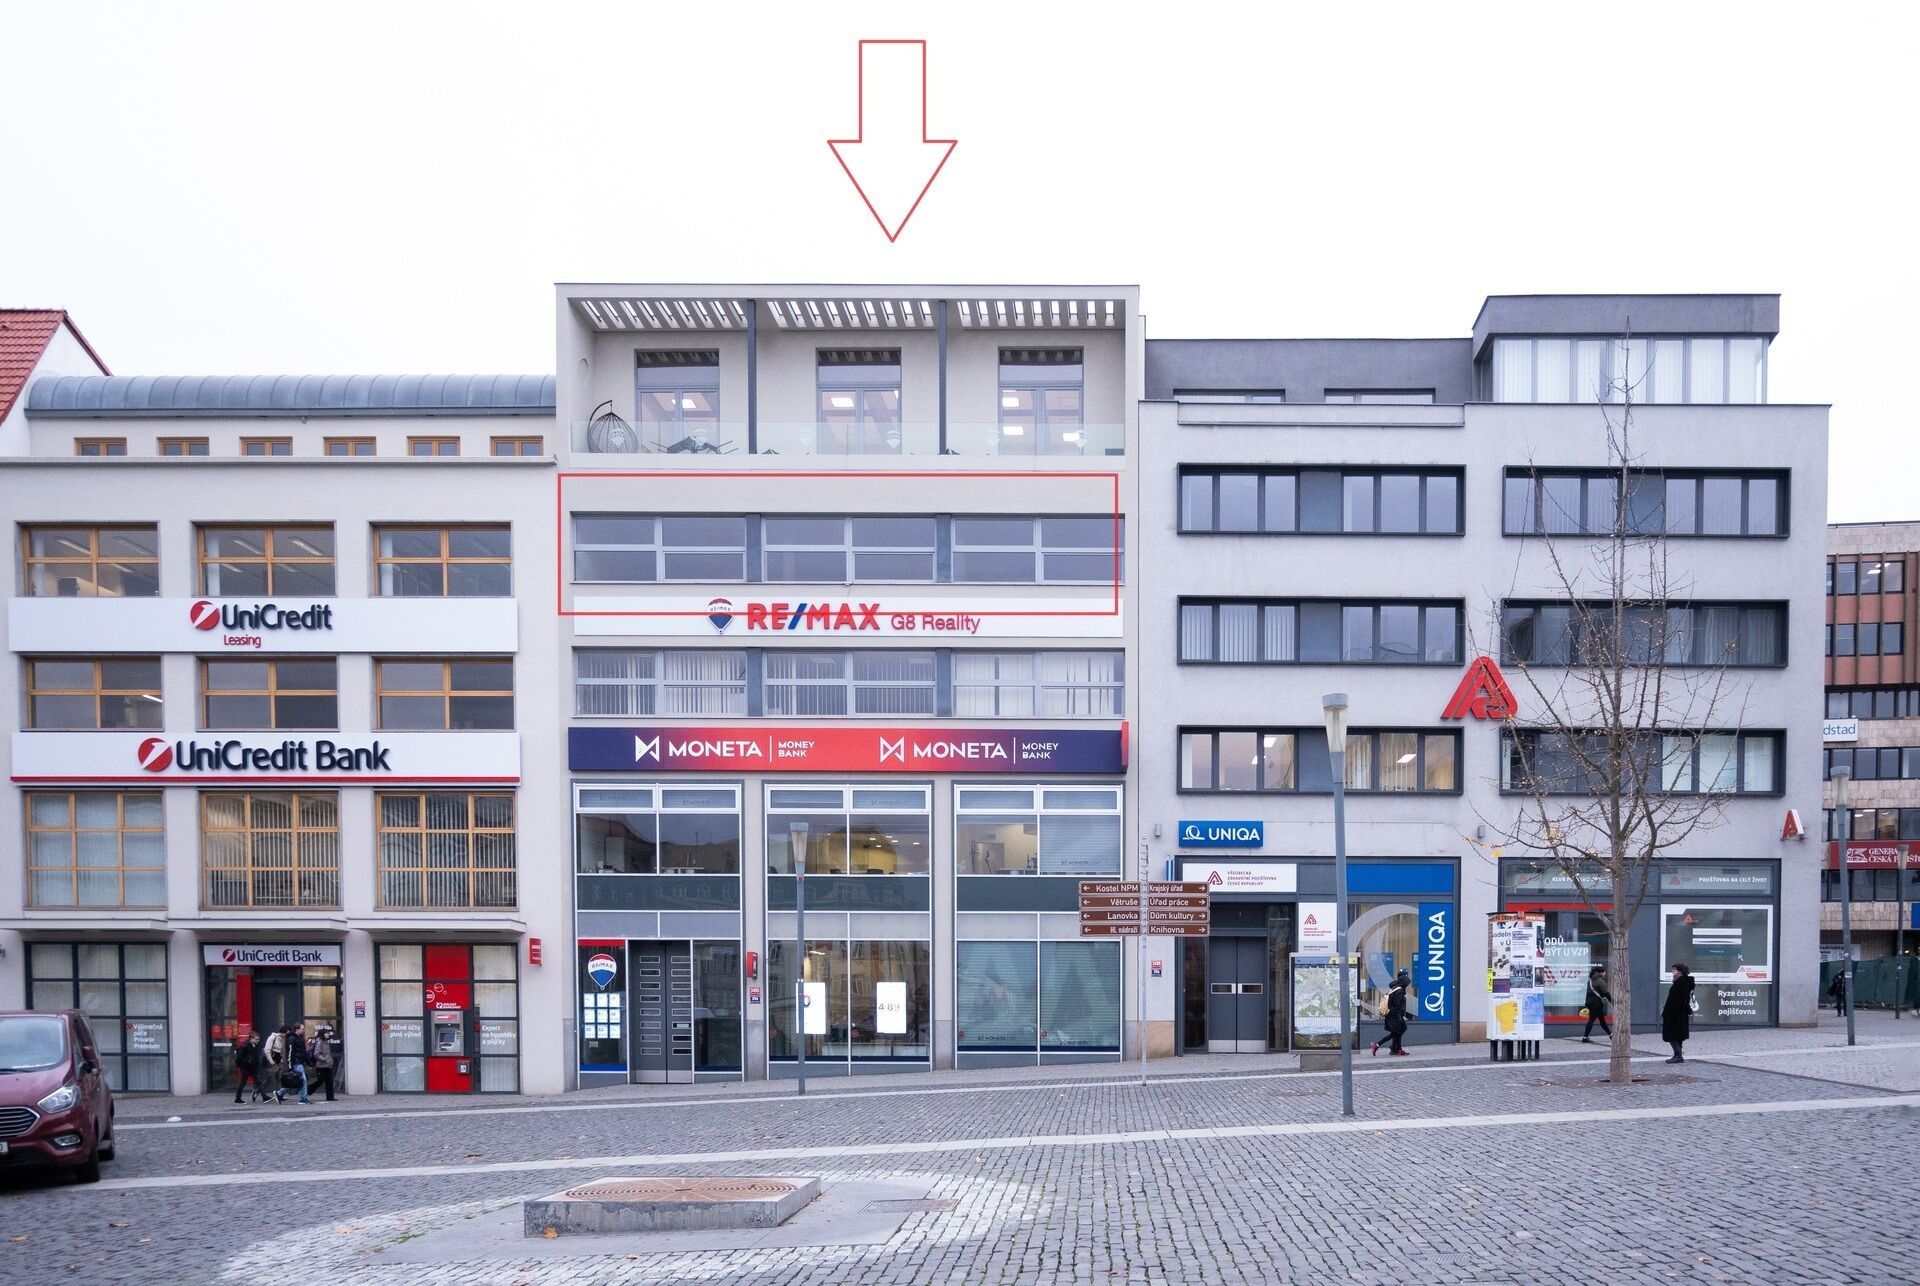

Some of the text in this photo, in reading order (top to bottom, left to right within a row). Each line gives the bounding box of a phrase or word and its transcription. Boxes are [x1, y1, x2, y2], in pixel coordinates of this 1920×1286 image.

[222, 604, 333, 630] UniCredit
[747, 603, 980, 634] RE/MAX G8 Reality
[223, 635, 261, 648] Leasing
[668, 741, 763, 757] MONETA
[778, 741, 815, 749] MONEY
[1022, 743, 1059, 751] MONEY
[778, 749, 808, 758] BANK
[913, 742, 1008, 758] MONETA
[176, 740, 392, 771] UniCredit Bank
[1022, 751, 1051, 759] BANK
[1208, 828, 1260, 840] UNIQA
[1868, 855, 1892, 863] ČESKÁ
[1149, 884, 1183, 893] Krajský úřad
[1149, 898, 1189, 907] Úřad práce
[1169, 912, 1194, 920] kultury
[1151, 926, 1185, 934] Knihovna
[1544, 935, 1567, 946] ODŮ,
[1428, 911, 1445, 980] UNIQA
[1545, 946, 1589, 956] BÝT U VZP
[237, 950, 322, 962] UniCredit Bank
[1560, 970, 1580, 979] VZP
[1717, 989, 1757, 998] Ryze česká
[1720, 998, 1754, 1006] komerční
[1718, 1008, 1756, 1016] pojišťovna
